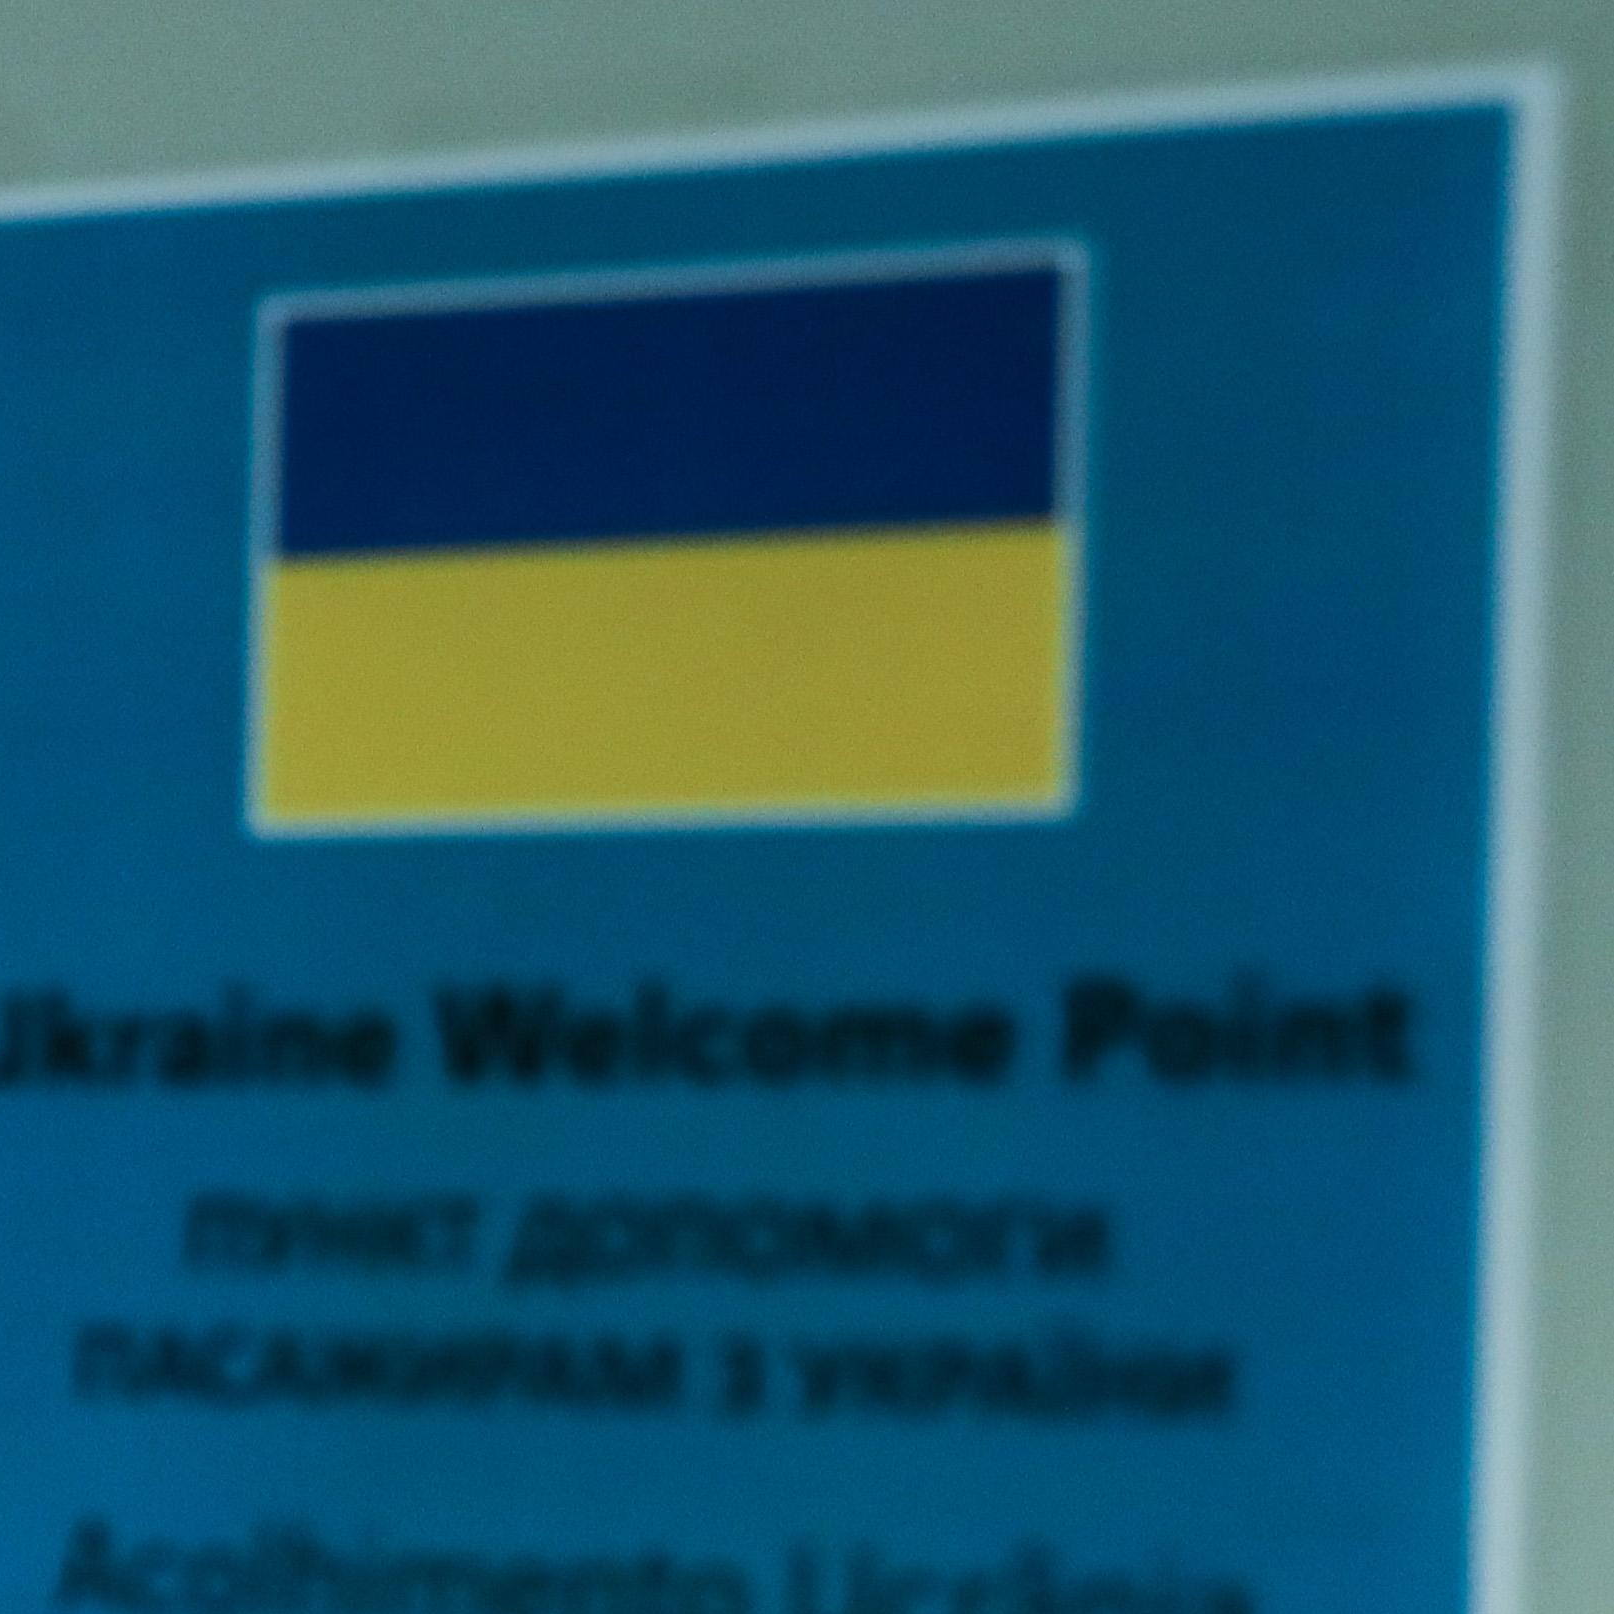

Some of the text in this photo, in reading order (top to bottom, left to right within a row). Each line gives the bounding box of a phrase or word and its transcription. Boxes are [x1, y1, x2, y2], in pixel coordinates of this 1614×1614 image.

[431, 974, 1017, 1087] Welcome
[1053, 970, 1423, 1086] Point
[179, 1190, 1117, 1291] ПУНКТ ДОПОМОГИ
[69, 1320, 682, 1416] ПАСАЖИРАМ
[790, 1324, 1239, 1425] УКРАЇНИ
